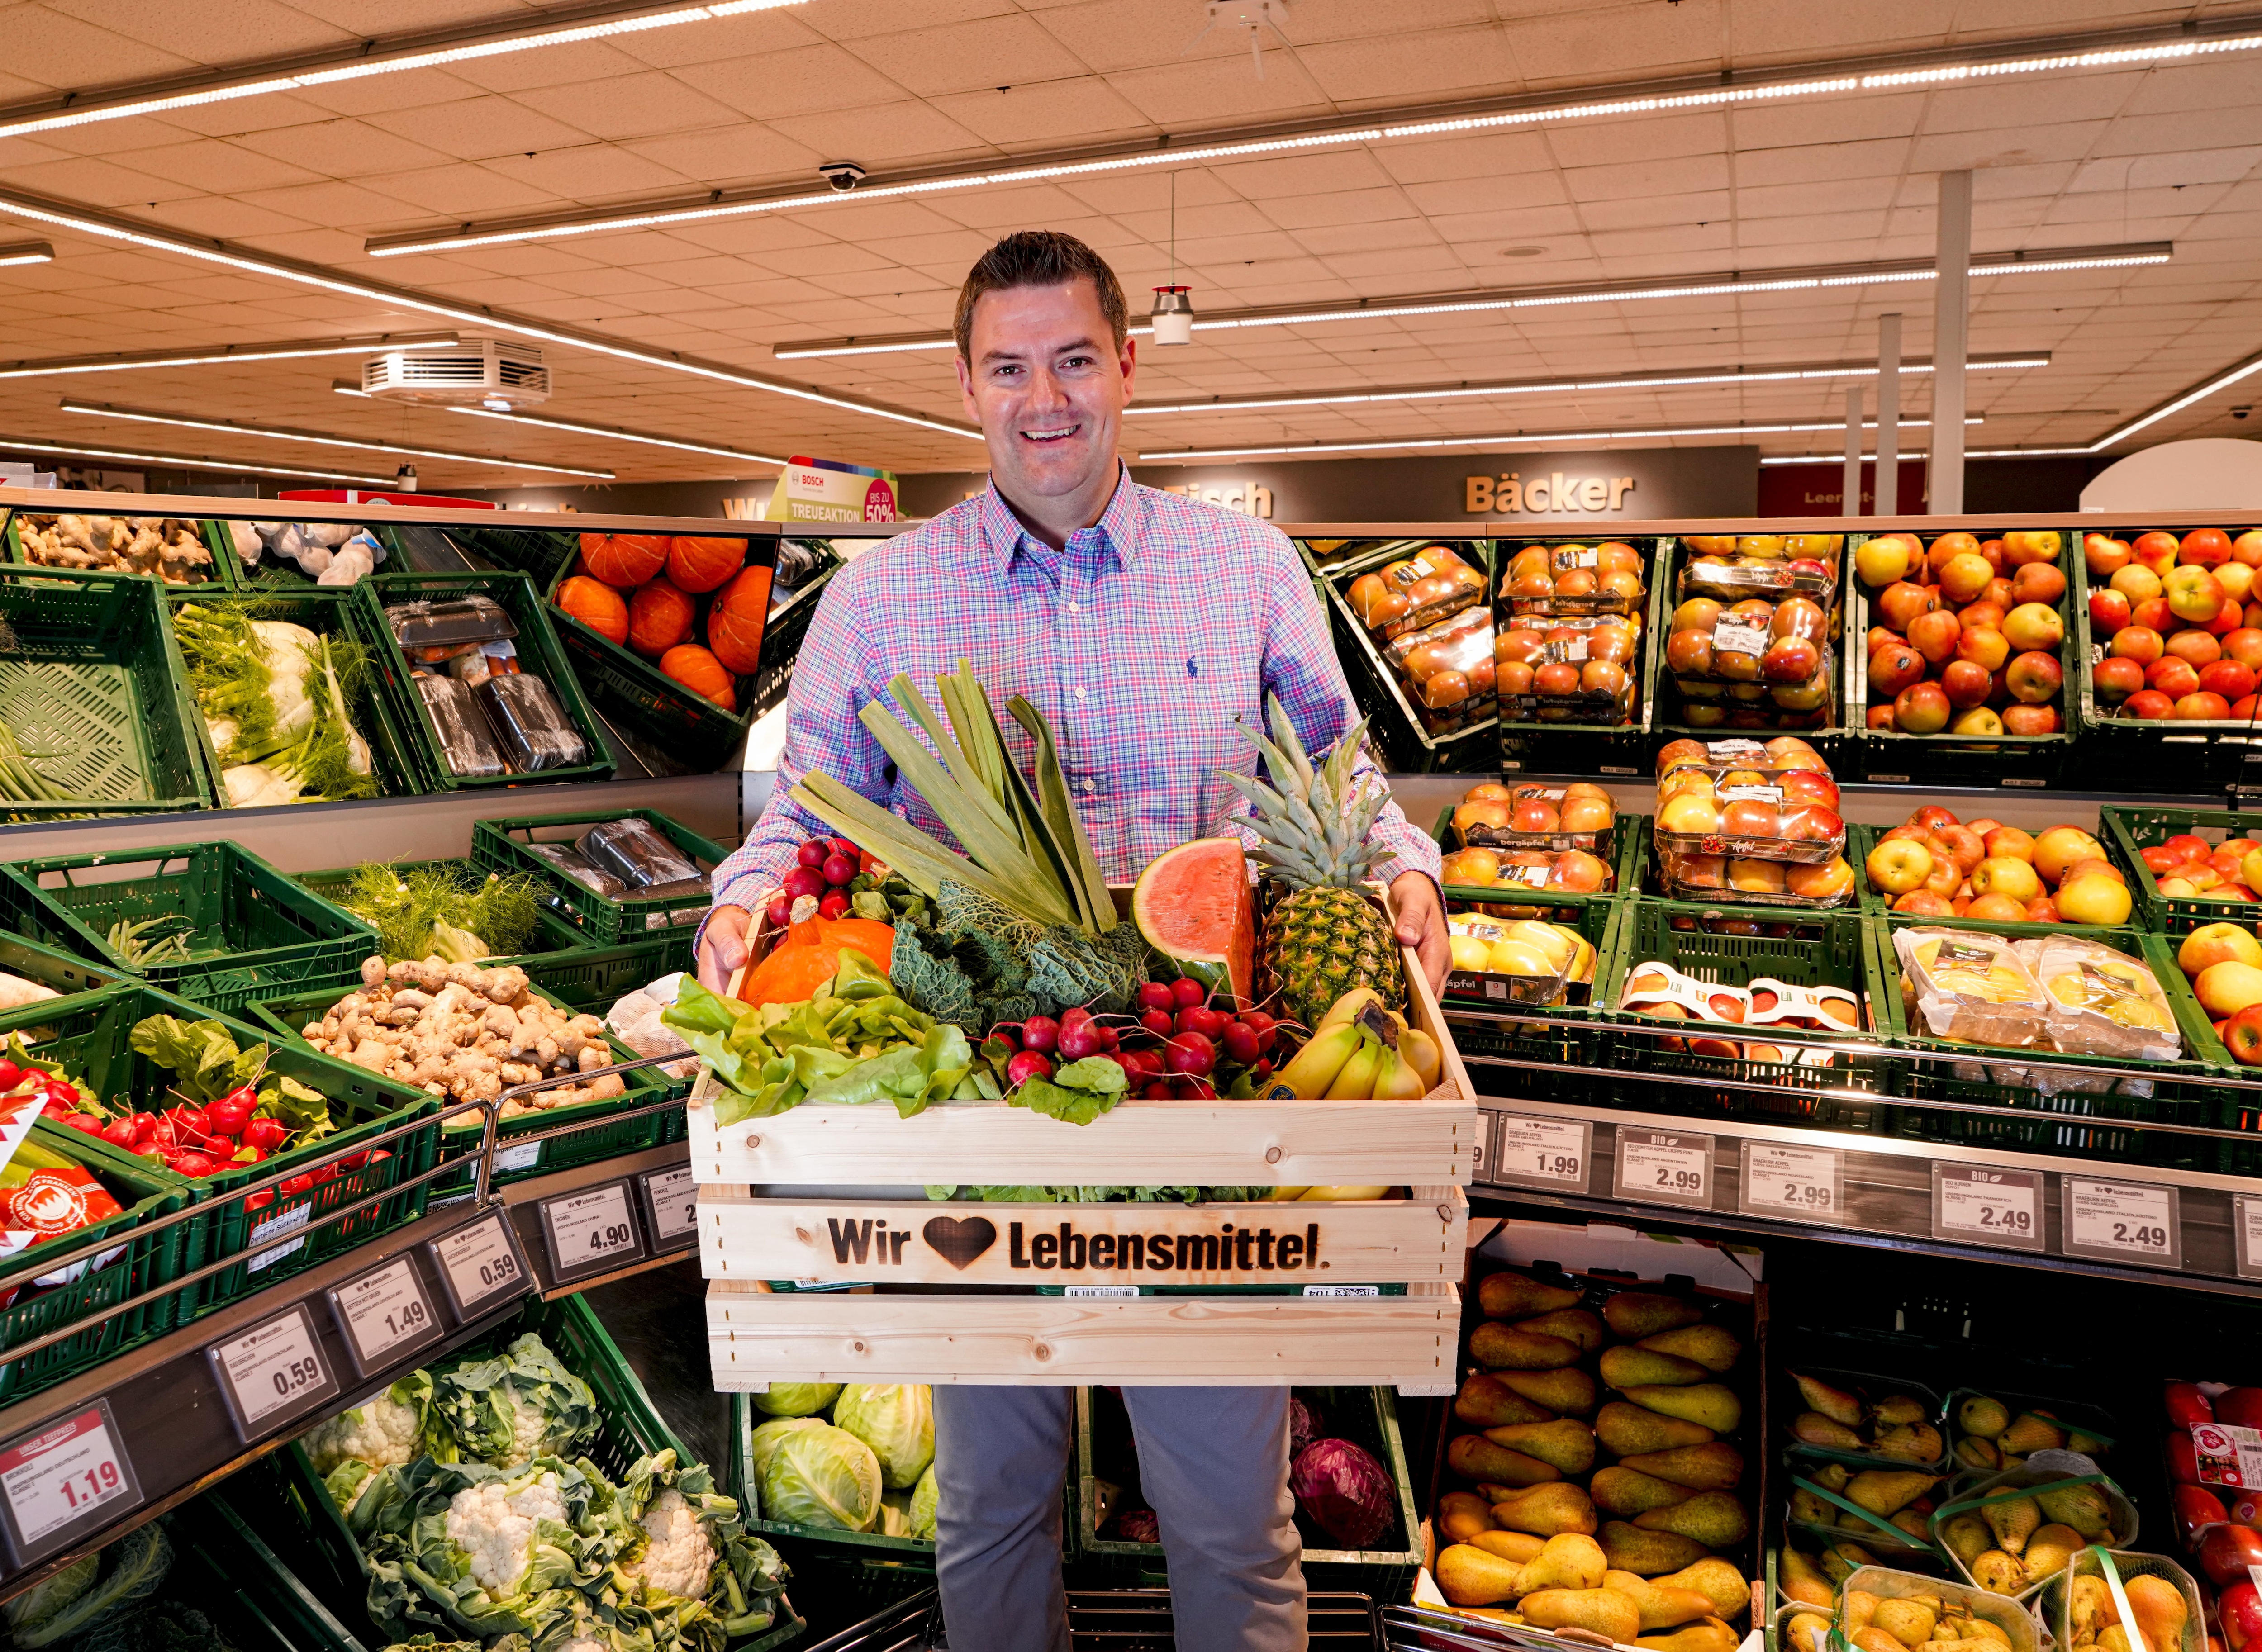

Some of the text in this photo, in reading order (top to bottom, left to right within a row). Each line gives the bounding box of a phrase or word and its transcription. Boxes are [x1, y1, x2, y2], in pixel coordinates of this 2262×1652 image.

[802, 475, 824, 487] BOSCH
[870, 492, 889, 503] BIS ZU
[1467, 472, 1633, 513] Bäcker
[792, 503, 860, 522] TREUEAKTION
[866, 504, 894, 522] 50%
[1731, 840, 1755, 853] Äpfel
[1445, 979, 1476, 988] äpfel
[1651, 1135, 1666, 1145] BIO
[1537, 1154, 1578, 1174] 1.99
[1656, 1168, 1701, 1190] 2.99
[1972, 1171, 1988, 1182] BIO
[655, 1192, 684, 1203] URSPRUNGSLAND
[1784, 1183, 1831, 1206] 2.99
[19, 1211, 32, 1222] ICH
[555, 1215, 570, 1223] INGWER
[556, 1219, 588, 1230] URSPRUNGSLAND
[1980, 1207, 2030, 1230] 2.49
[251, 1228, 275, 1244] Deutsche
[276, 1212, 308, 1231] Süßkirschen
[590, 1223, 630, 1250] 4.90
[2113, 1223, 2166, 1247] 2.49
[446, 1245, 471, 1261] LAUCHZWIEBELN
[827, 1218, 1331, 1271] Wir Lebensmittel.
[449, 1243, 495, 1268] URSPRUNGSLAND DEUTSCHLAND
[480, 1254, 515, 1285] 0.59
[347, 1300, 361, 1310] RETTICH
[369, 1290, 381, 1300] GRUEN
[351, 1290, 403, 1319] URSPRUNGSLAND DEUTSCHLAND
[352, 1313, 365, 1323] KLASSE
[385, 1301, 425, 1335] 1.49
[229, 1352, 255, 1369] RADIESCHEN
[233, 1344, 295, 1378] URSPRUNGSLAND DEUTSCHLAND
[235, 1372, 250, 1382] KLASSE
[273, 1356, 319, 1396] 0.59
[19, 1422, 77, 1455] UNSER TIEFPREIS
[5, 1463, 34, 1481] BROKKOLI
[10, 1466, 55, 1491] URSPRUNGSLAND
[55, 1448, 90, 1469] DEUTSCHLAND
[12, 1483, 31, 1496] KLASSE
[60, 1460, 119, 1508] 1.19
